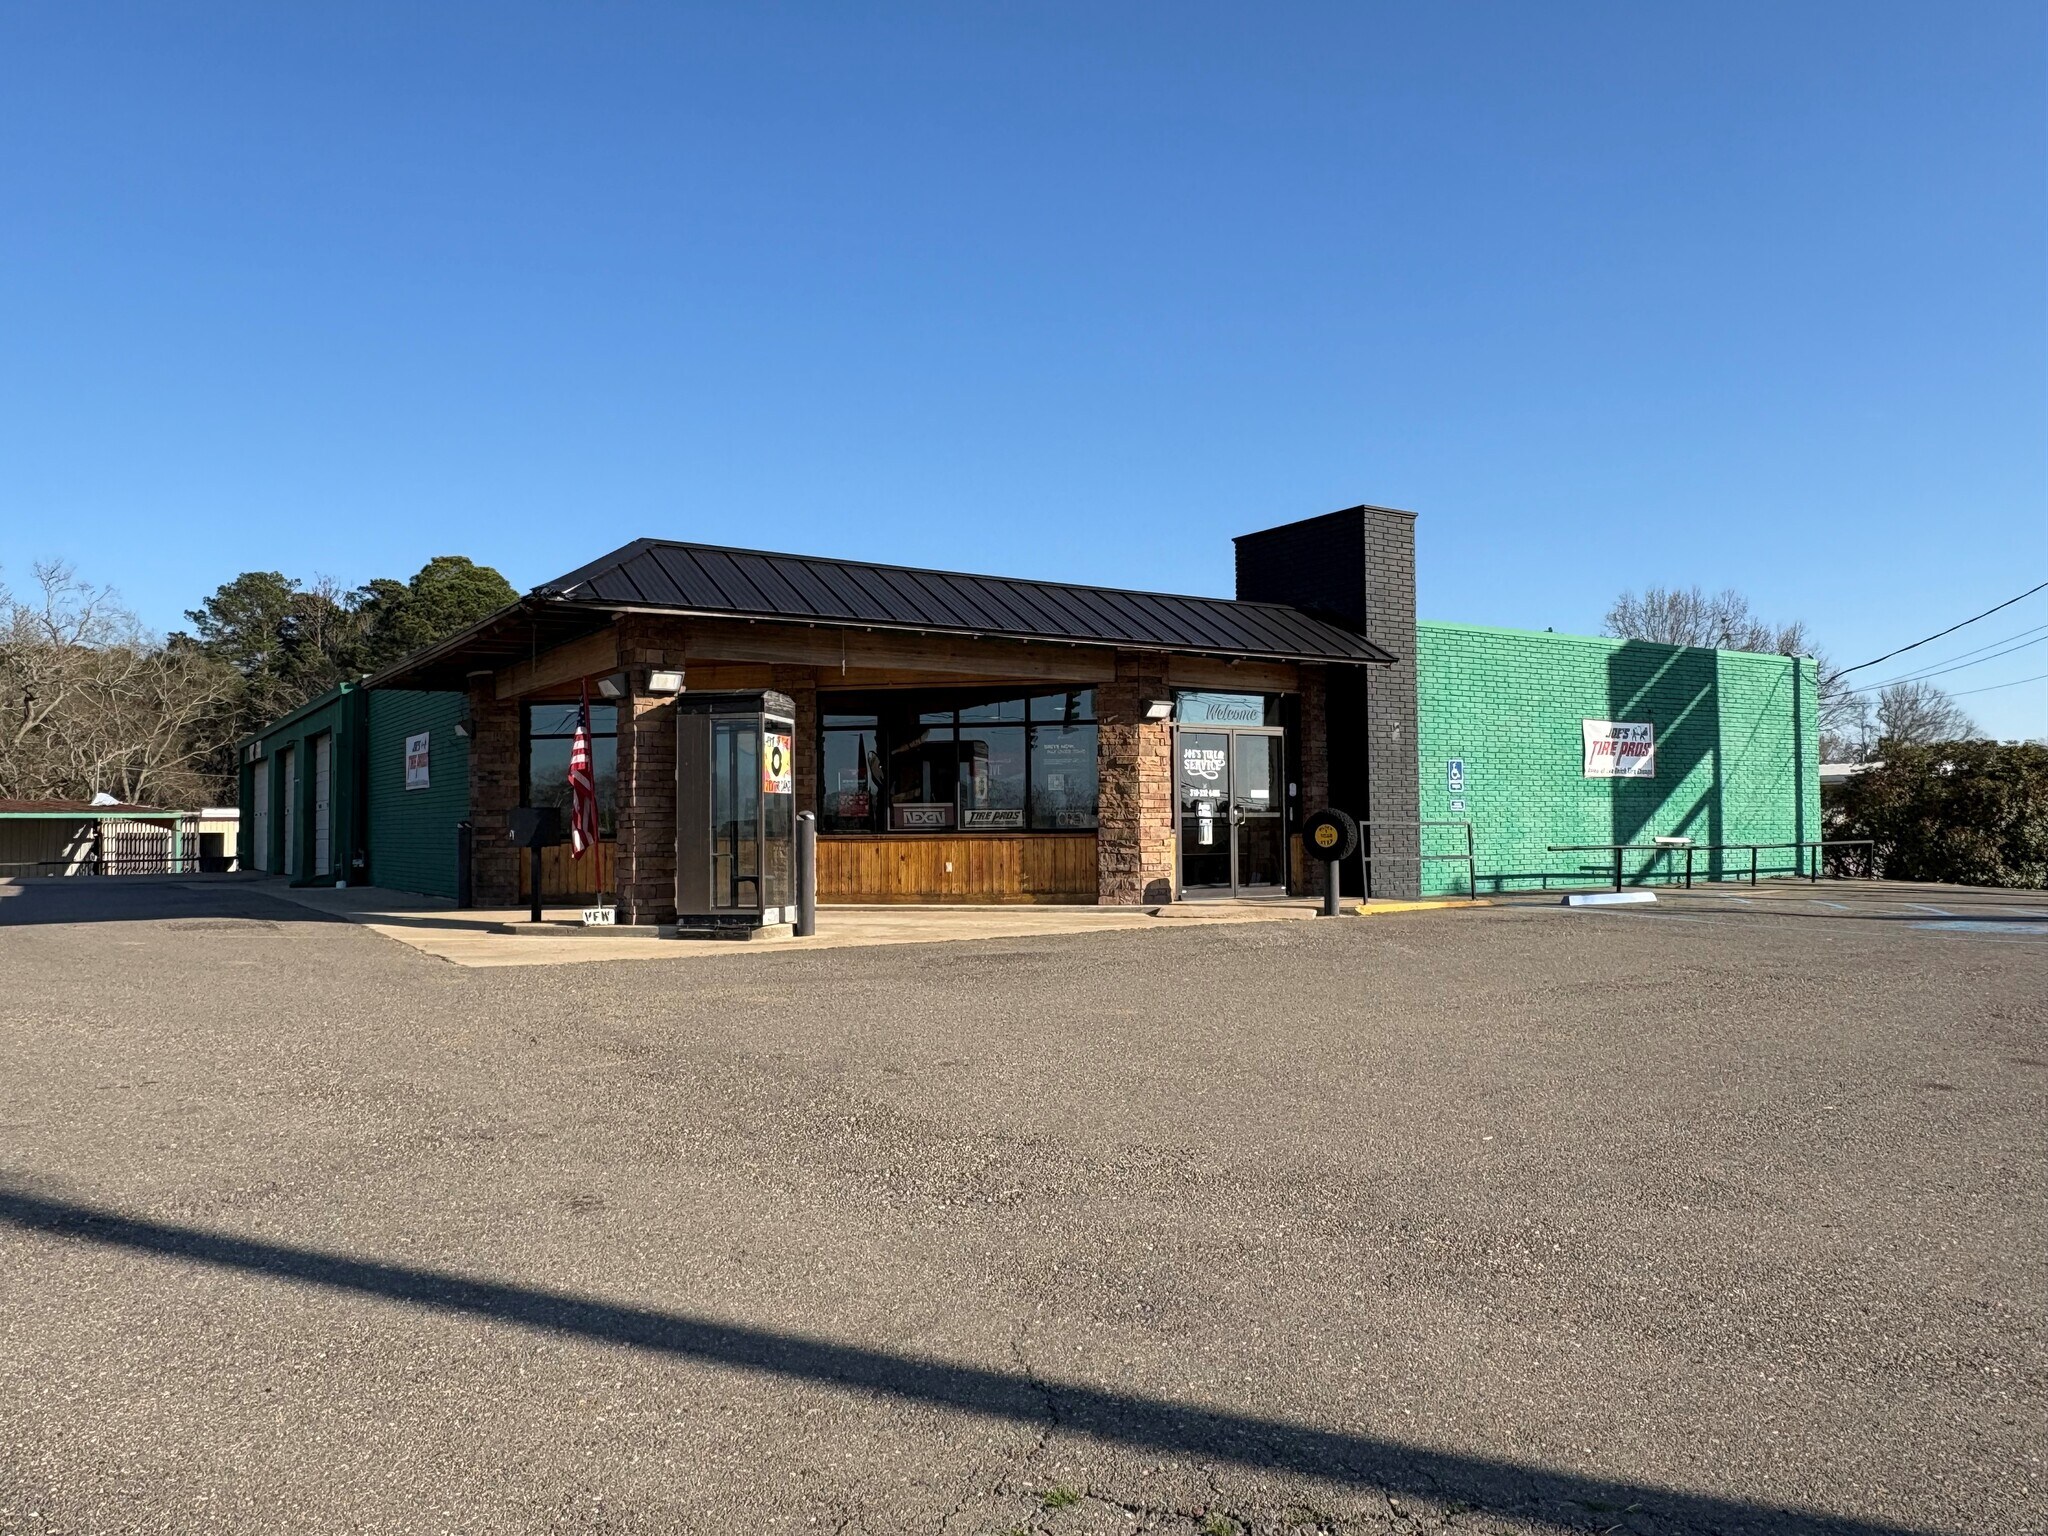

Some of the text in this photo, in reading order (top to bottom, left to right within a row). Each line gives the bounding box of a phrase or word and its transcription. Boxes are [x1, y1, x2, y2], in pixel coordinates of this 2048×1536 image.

[1205, 704, 1257, 721] Welcome
[1606, 728, 1630, 740] JOE'S
[1589, 741, 1652, 766] TIRE PROS
[1184, 759, 1226, 776] SERVICE
[903, 811, 946, 824] NEXEN
[969, 811, 1020, 825] TIRE PROS
[585, 911, 610, 921] VFW
